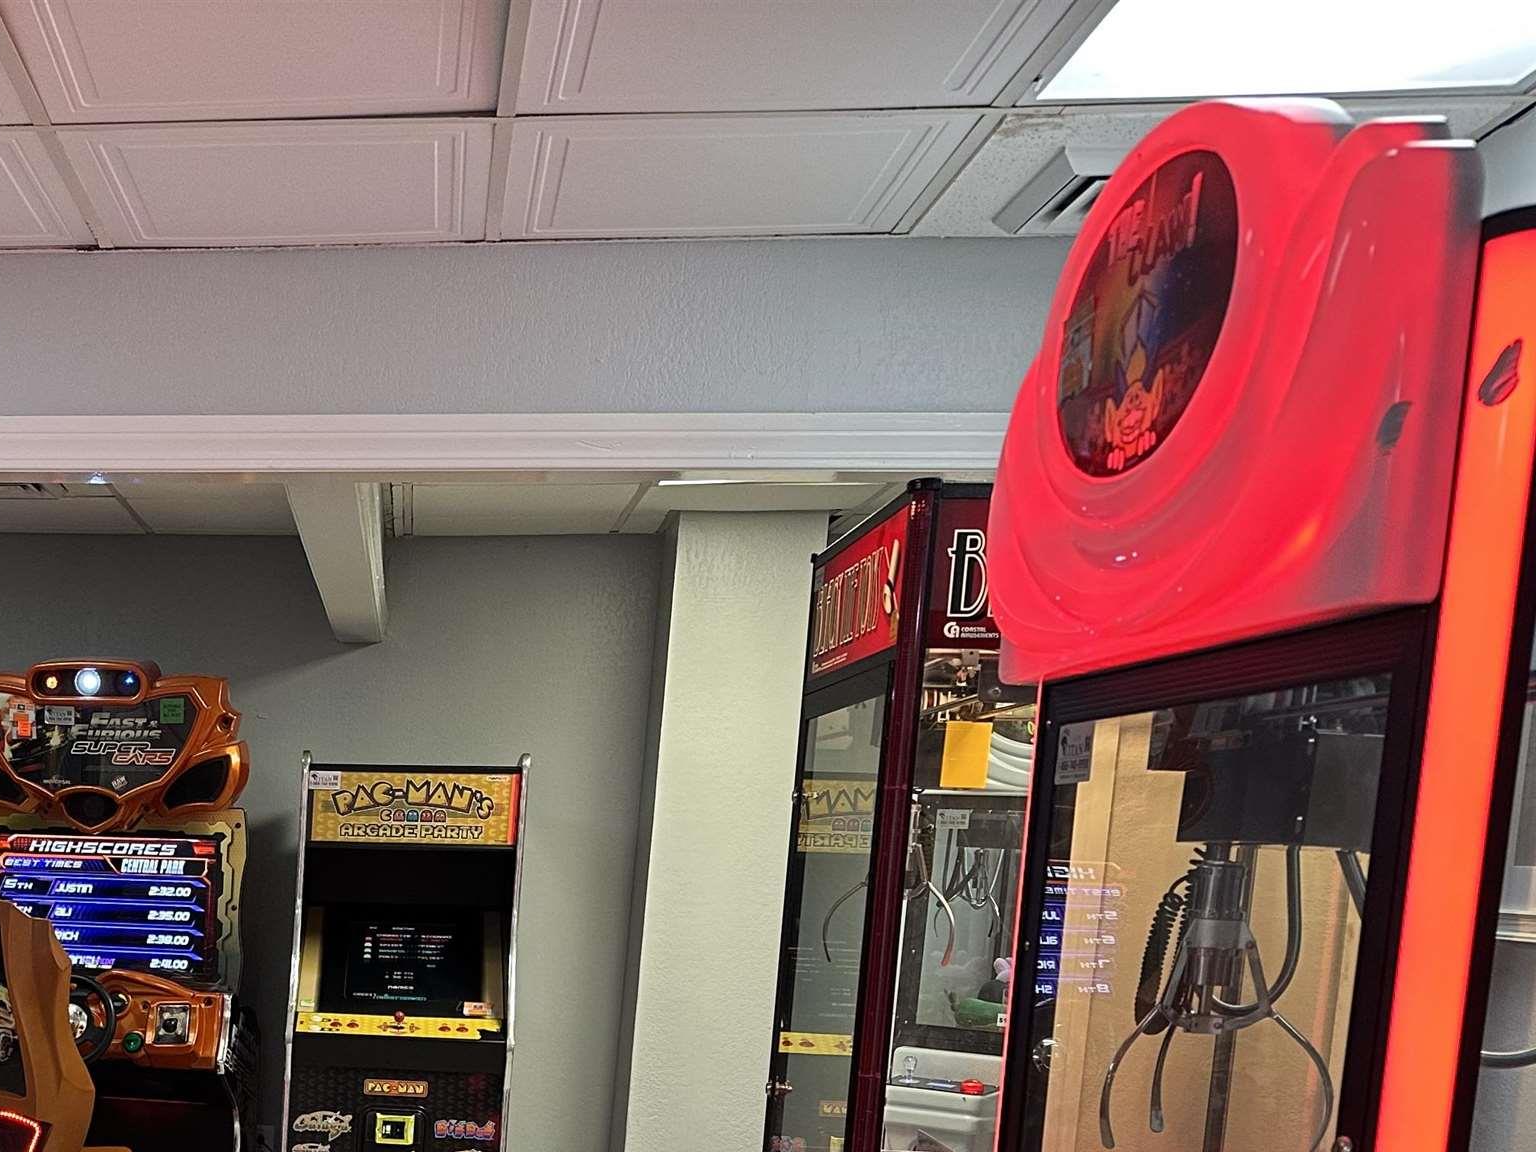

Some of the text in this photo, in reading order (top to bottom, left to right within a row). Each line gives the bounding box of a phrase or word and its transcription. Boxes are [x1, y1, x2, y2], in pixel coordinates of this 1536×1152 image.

[90, 712, 147, 729] FAST
[66, 724, 162, 740] FURIOUS
[70, 741, 151, 755] SUPER
[111, 749, 176, 765] CARS
[332, 780, 495, 819] PAC-MAN'S
[340, 824, 483, 839] ARCADE PARTY
[29, 839, 177, 856] HIGHSCORES
[5, 858, 186, 875] BEST TIMES CENTRAL PARK
[55, 883, 93, 893] JUSTIN
[368, 1082, 424, 1094] PAC-MAN
